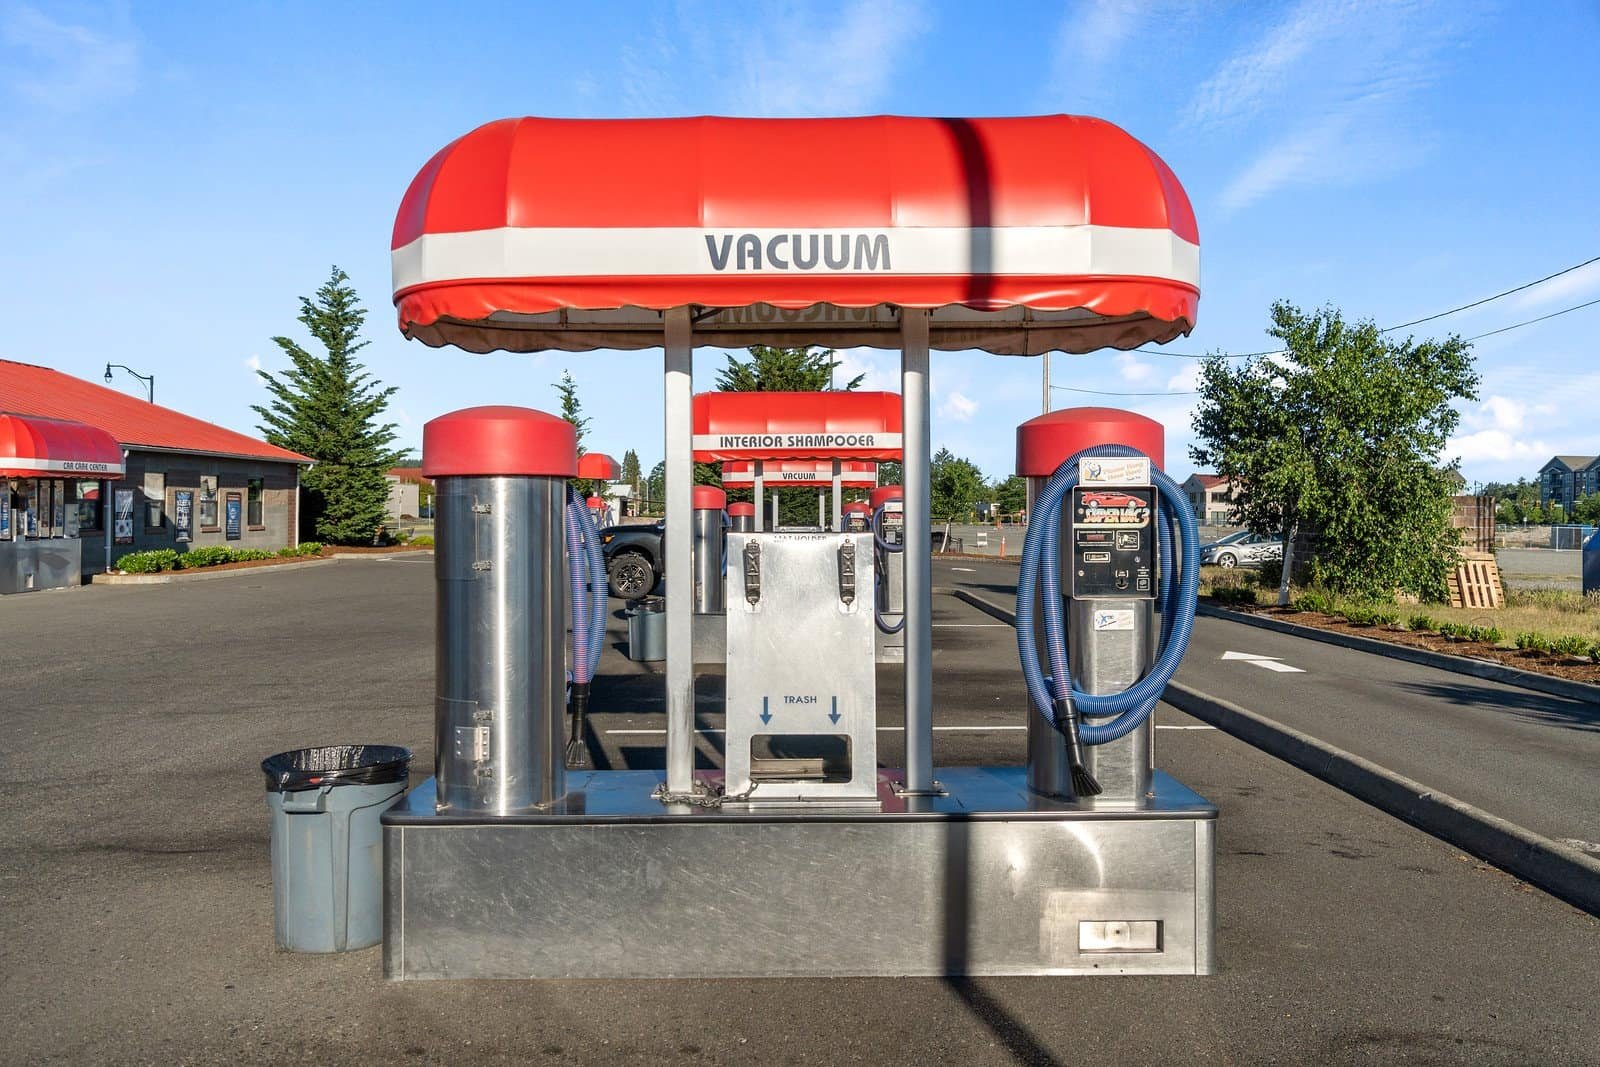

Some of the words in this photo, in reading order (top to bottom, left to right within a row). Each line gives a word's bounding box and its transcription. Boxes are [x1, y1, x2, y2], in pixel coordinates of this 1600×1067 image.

[704, 233, 892, 271] VACUUM
[720, 435, 783, 448] INTERIOR
[787, 434, 875, 447] SHAMPOOER
[89, 463, 108, 472] CENTER
[782, 472, 816, 481] VACUUM
[783, 695, 817, 704] TRASH
